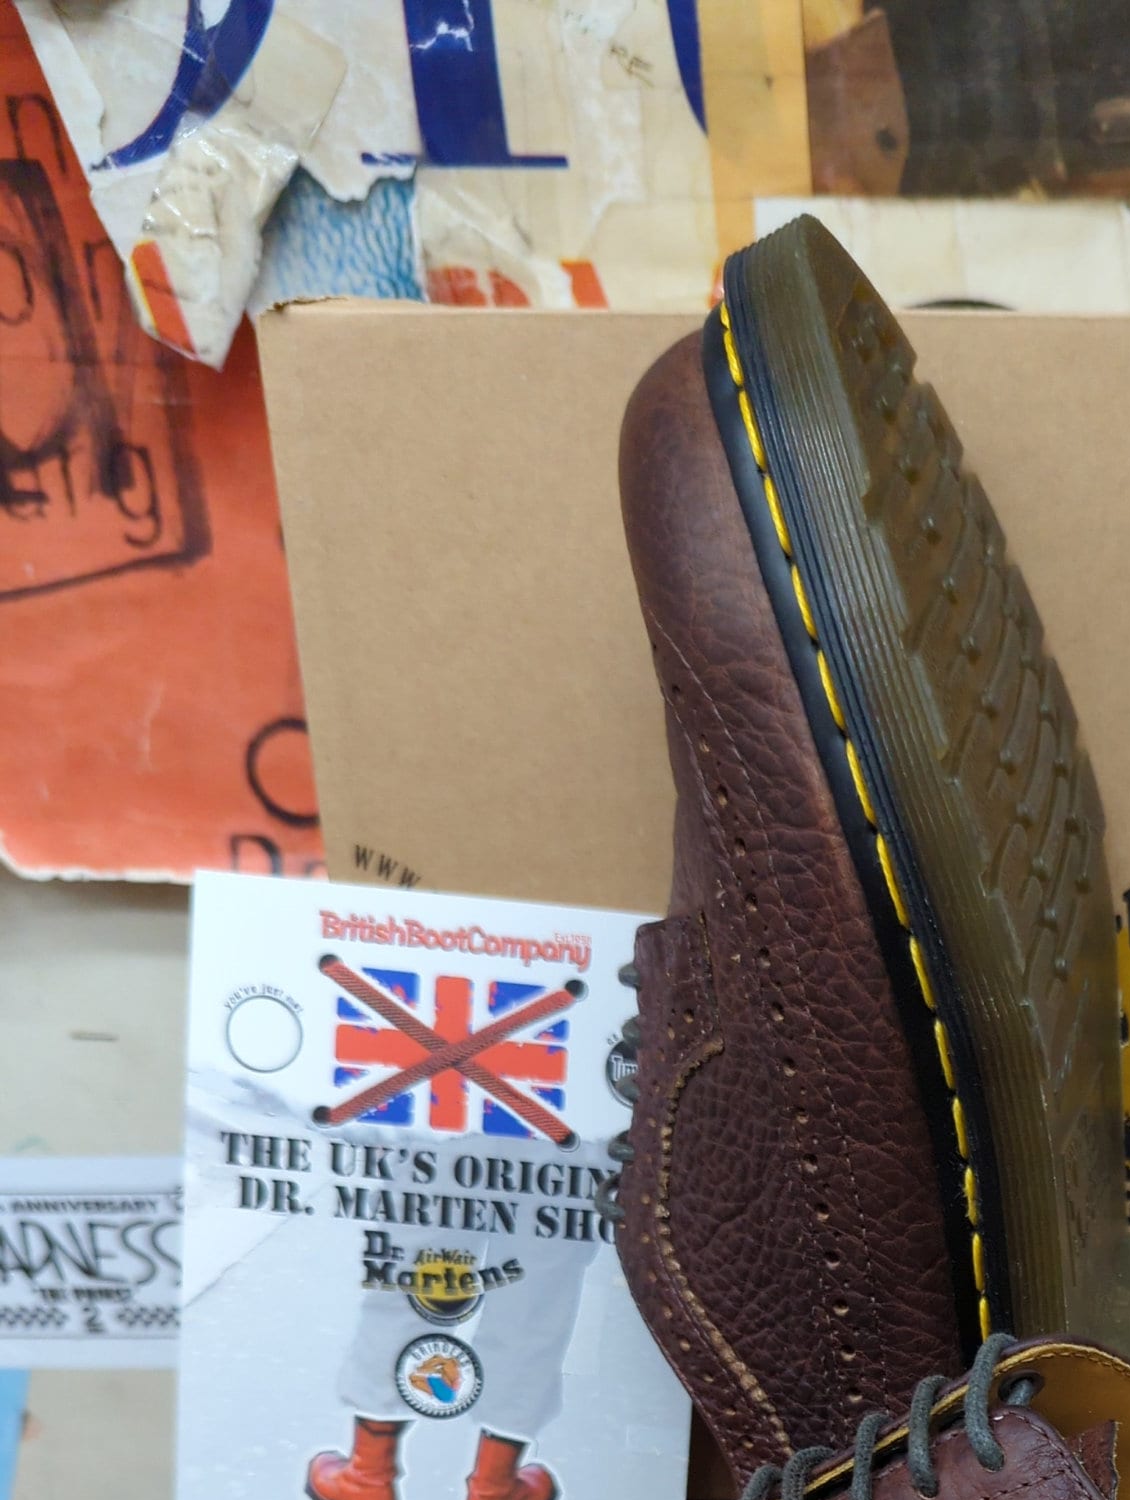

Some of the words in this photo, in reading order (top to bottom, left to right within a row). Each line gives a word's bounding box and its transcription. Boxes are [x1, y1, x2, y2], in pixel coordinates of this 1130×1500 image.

[221, 1131, 312, 1174] THE
[328, 1143, 437, 1186] UK'S
[240, 1176, 315, 1217] DR.
[334, 1185, 517, 1236] MARTEN
[361, 1257, 526, 1293] Martens
